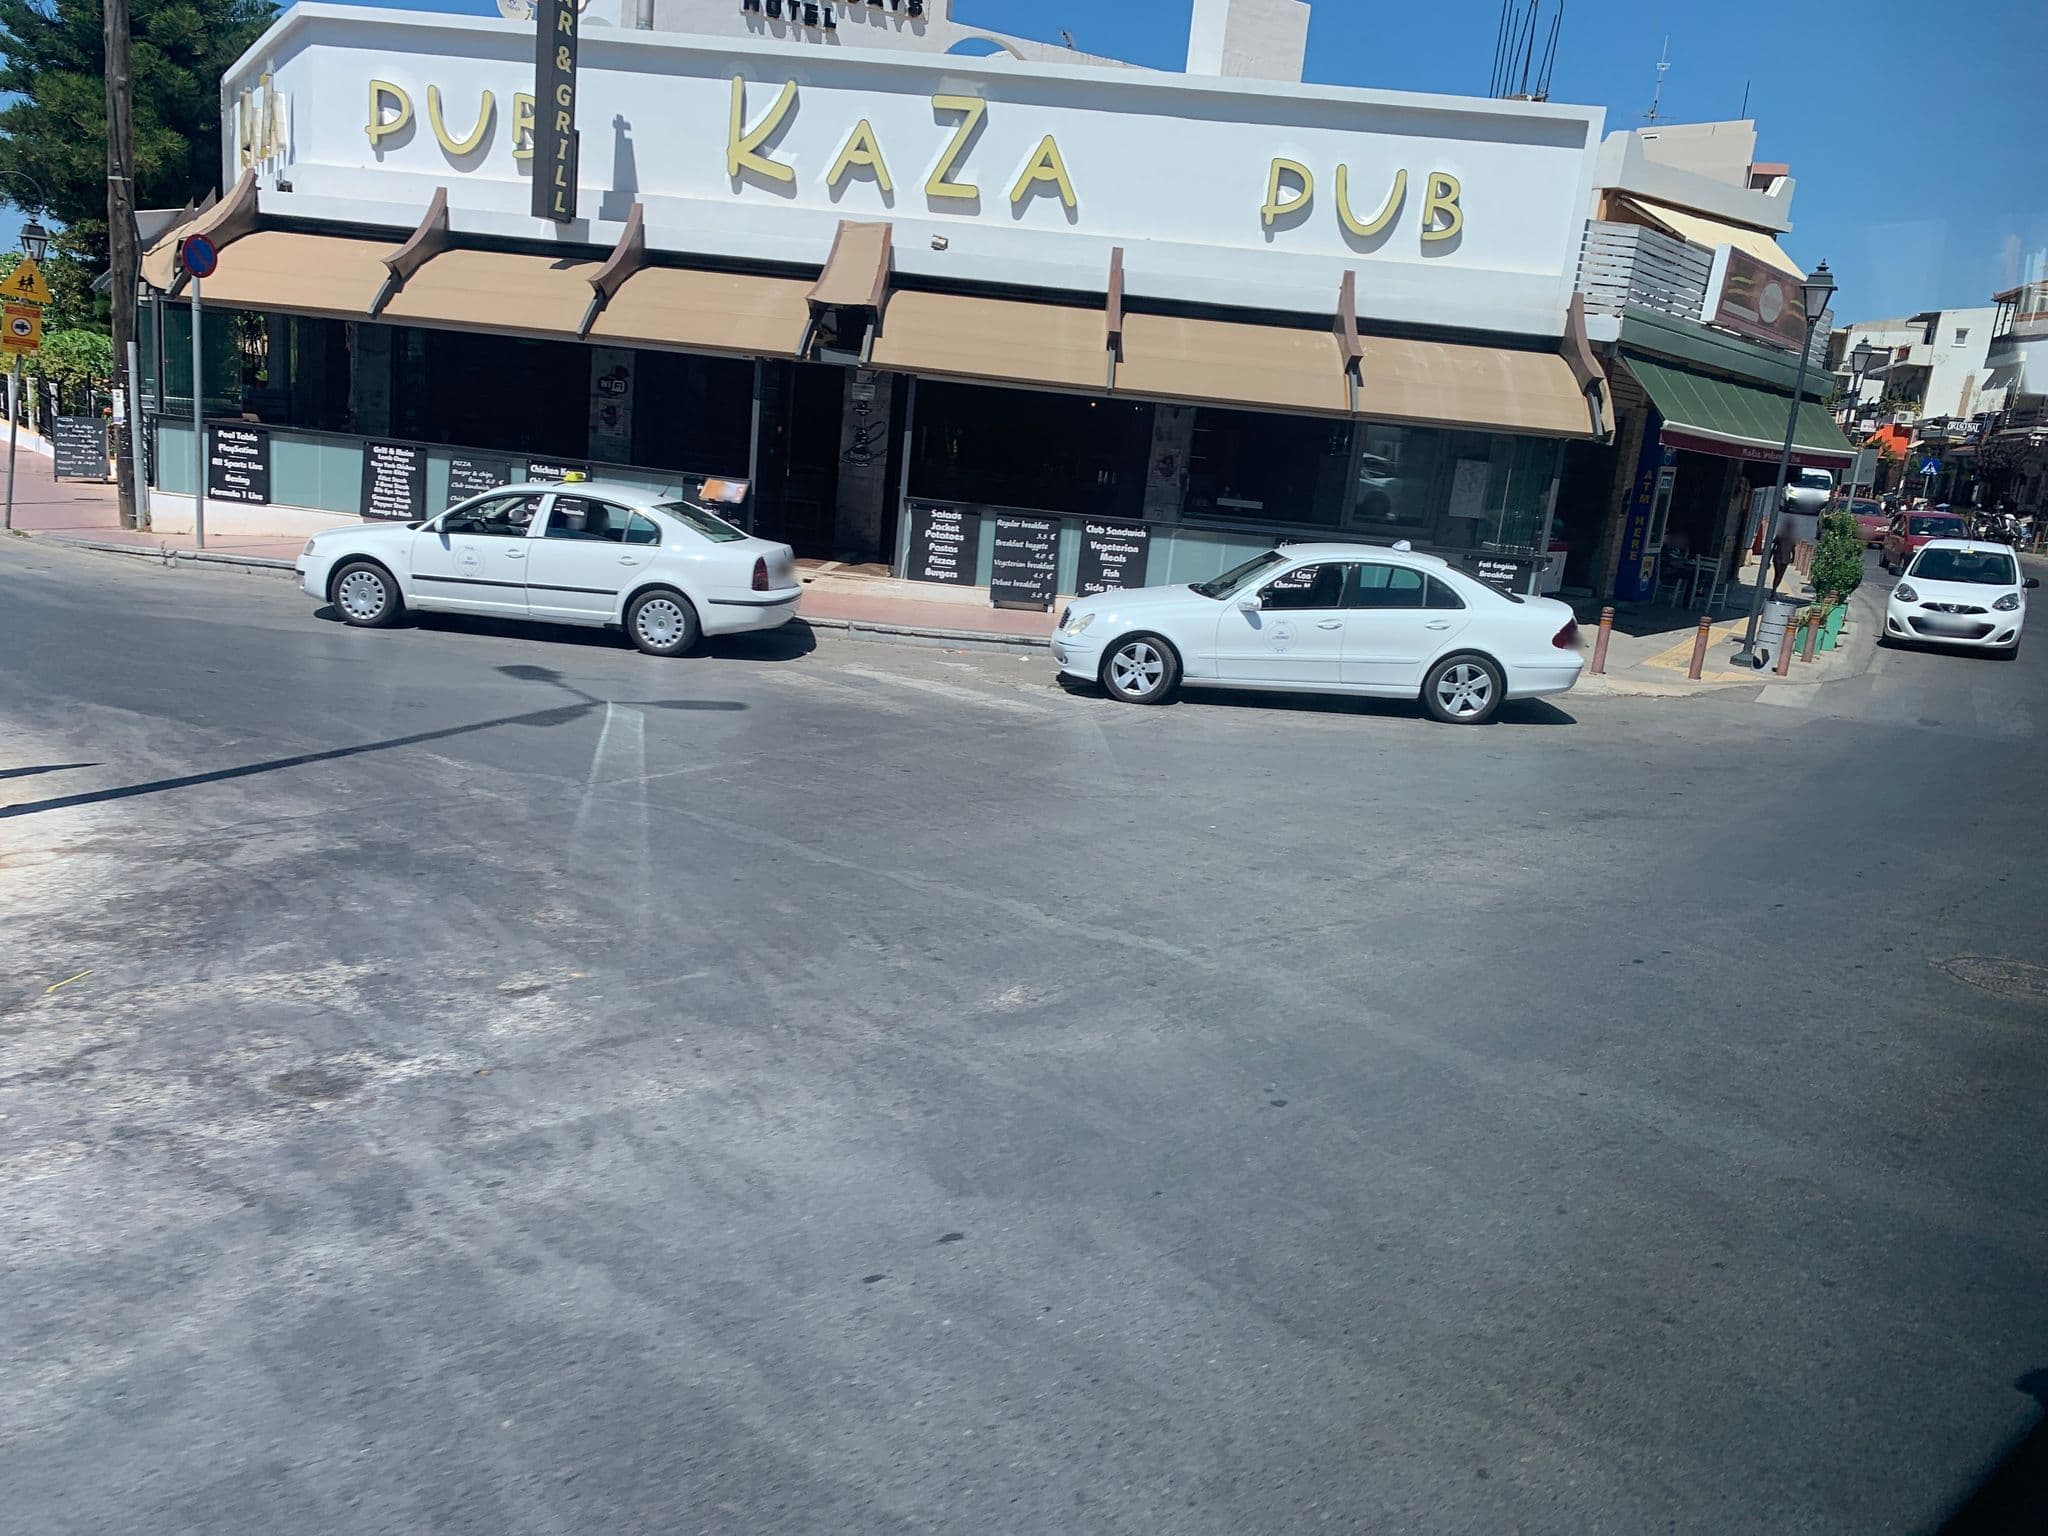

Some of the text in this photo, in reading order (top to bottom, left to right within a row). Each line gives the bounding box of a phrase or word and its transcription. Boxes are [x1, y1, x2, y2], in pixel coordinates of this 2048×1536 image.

[556, 45, 572, 74] &
[727, 75, 1077, 207] KAZA
[554, 83, 573, 213] GRILL
[1261, 158, 1464, 240] PUB
[218, 430, 258, 442] Pool Table
[373, 446, 388, 454] Grill
[224, 459, 247, 469] Sports
[248, 462, 264, 470] Live
[530, 465, 559, 475] Chicken
[225, 474, 250, 486] Boxing
[211, 487, 264, 500] Formula 1 Live
[930, 509, 962, 520] Salads
[930, 522, 960, 532] Jacket
[997, 519, 1050, 530] Regular breakfast
[925, 529, 965, 541] Potatoes
[1086, 525, 1146, 537] Club Sandwich
[1050, 533, 1056, 541] €
[929, 543, 959, 553] Pastas
[995, 539, 1024, 548] Breakfast
[928, 555, 957, 565] Pizzas
[1099, 553, 1127, 562] Meals
[1027, 561, 1055, 570] breakfast
[1493, 562, 1518, 571] English
[925, 567, 958, 579] Burgers
[1046, 572, 1053, 580] €
[1103, 568, 1120, 578] Fish
[1479, 570, 1514, 580] Breakfast
[1013, 580, 1041, 588] breakfast
[1084, 583, 1105, 592] Side
